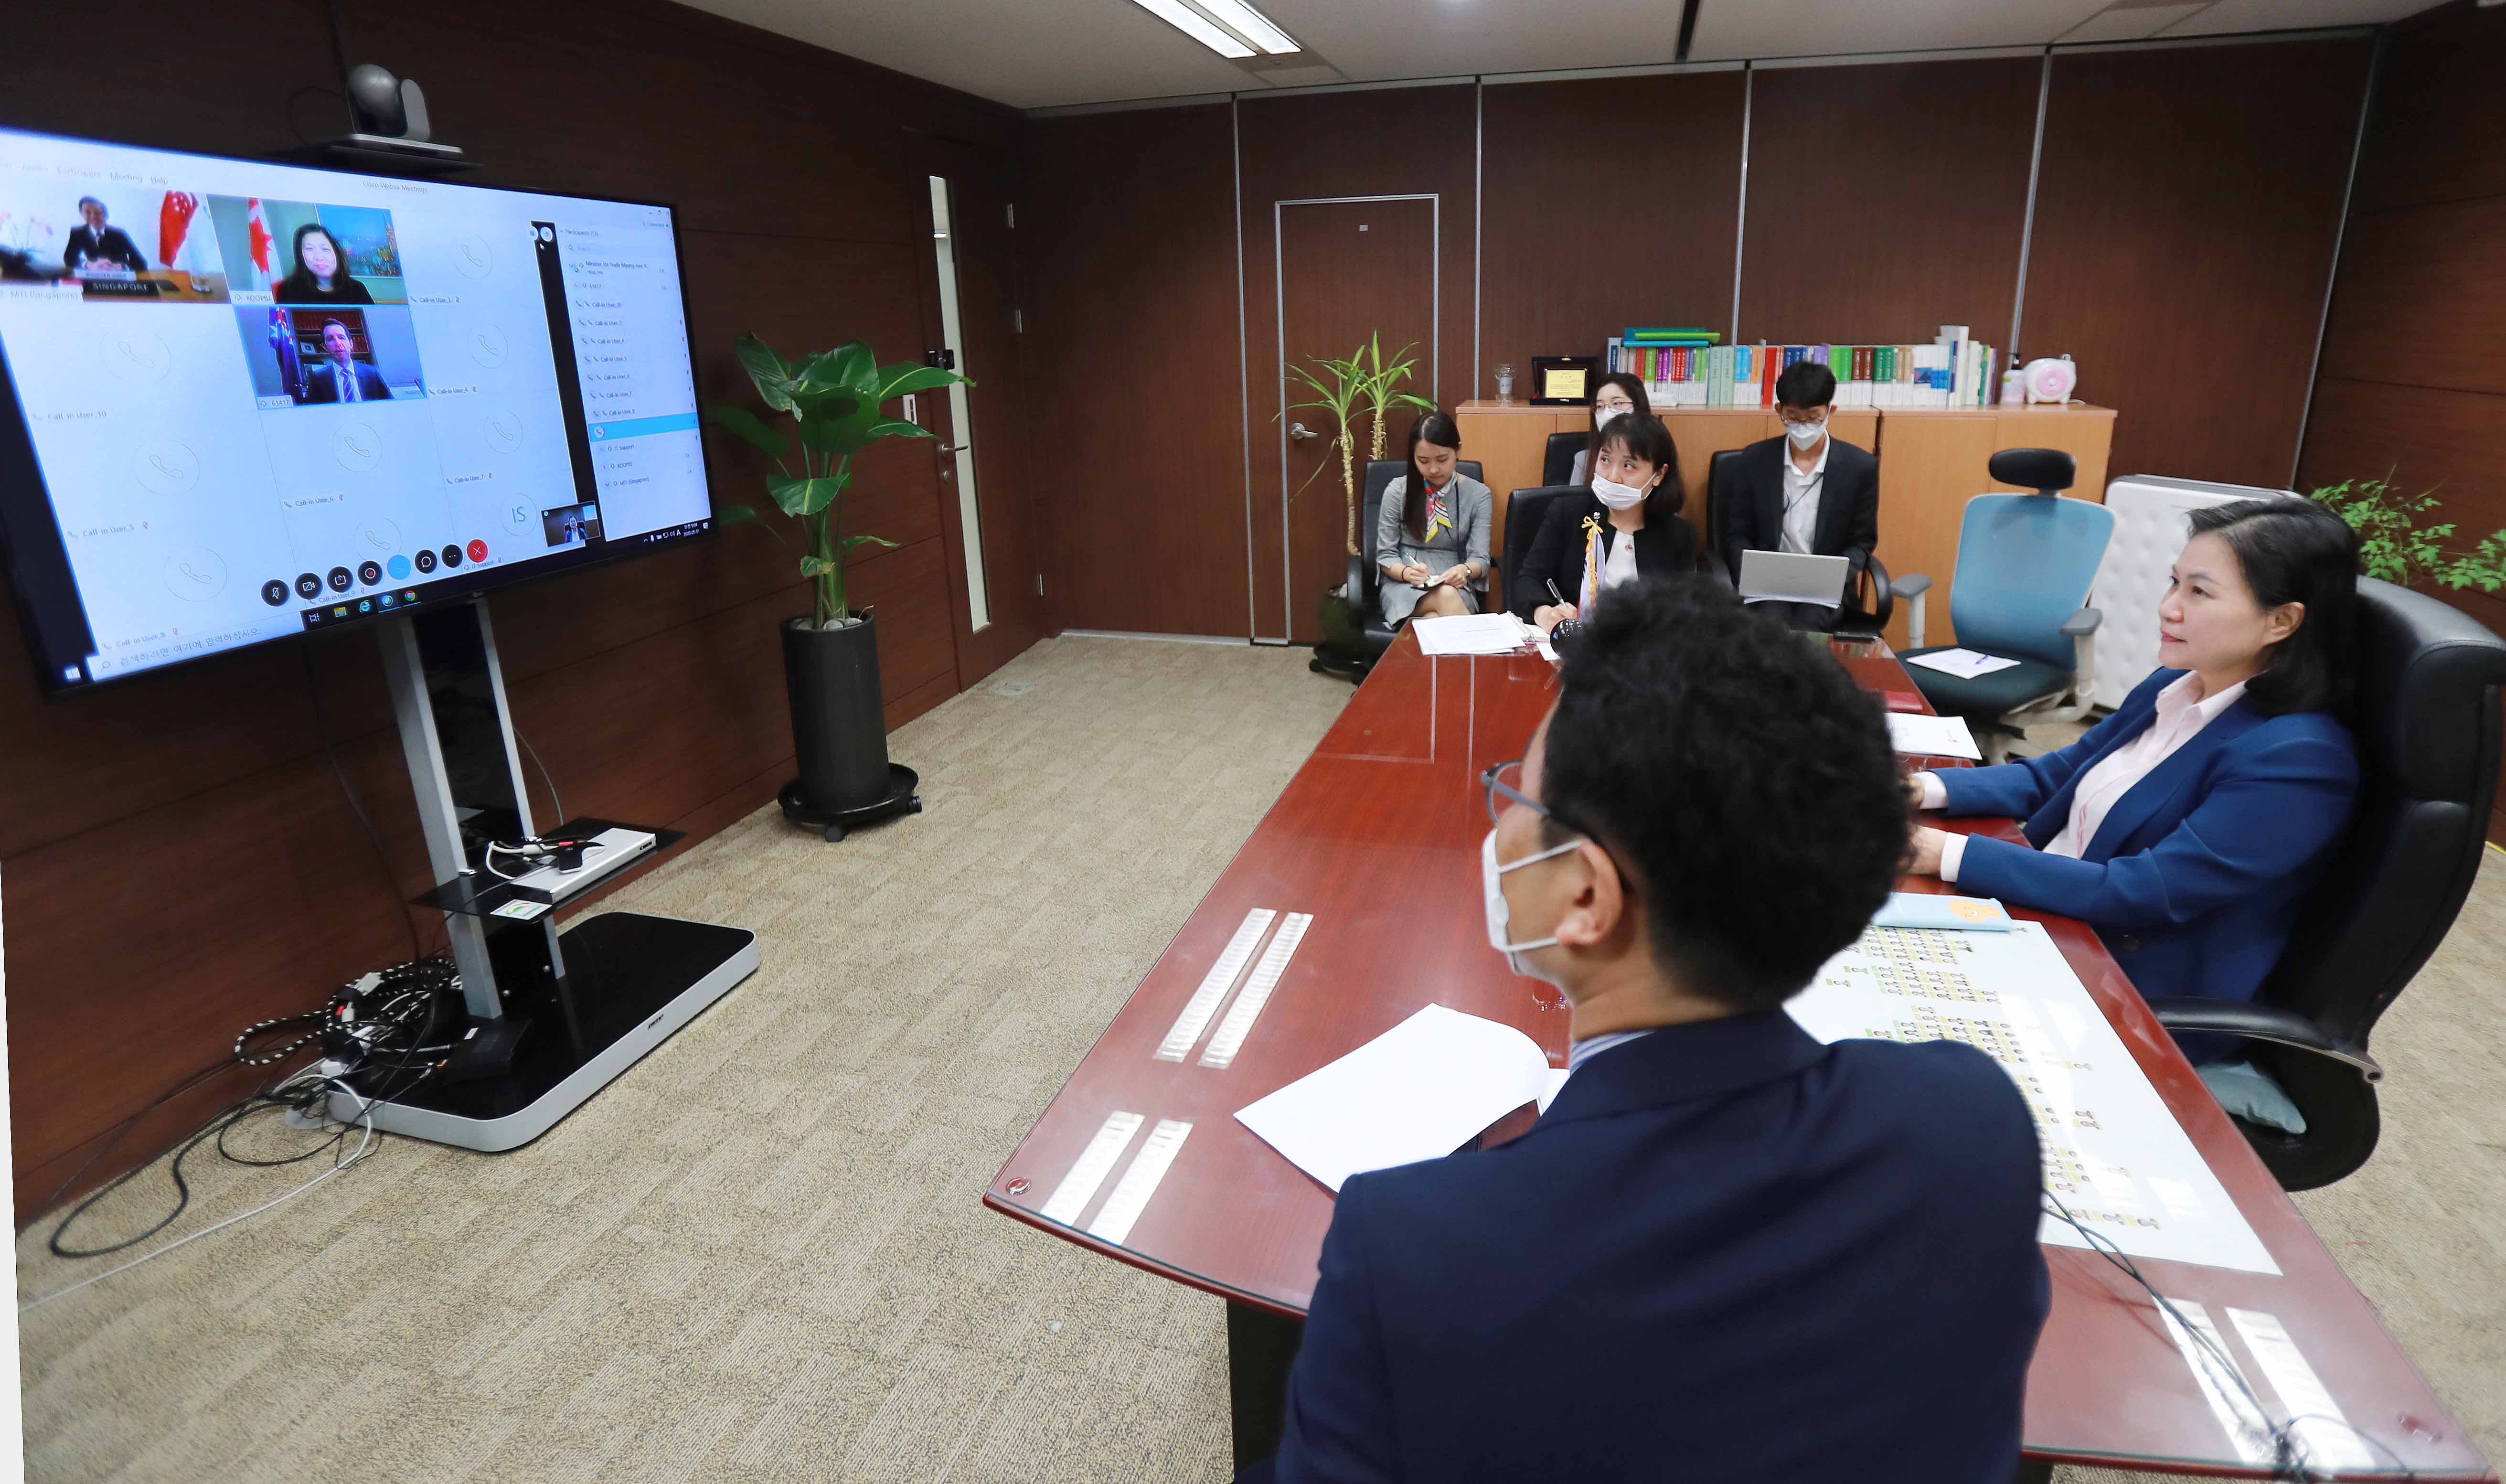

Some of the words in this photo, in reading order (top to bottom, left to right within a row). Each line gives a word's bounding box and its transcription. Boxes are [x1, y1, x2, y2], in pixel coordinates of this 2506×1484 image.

[150, 175, 168, 186] Help
[93, 282, 149, 291] SINGAPORE
[512, 506, 525, 523] IS
[120, 647, 169, 667] 검색하려면
[173, 641, 203, 653] 여기에
